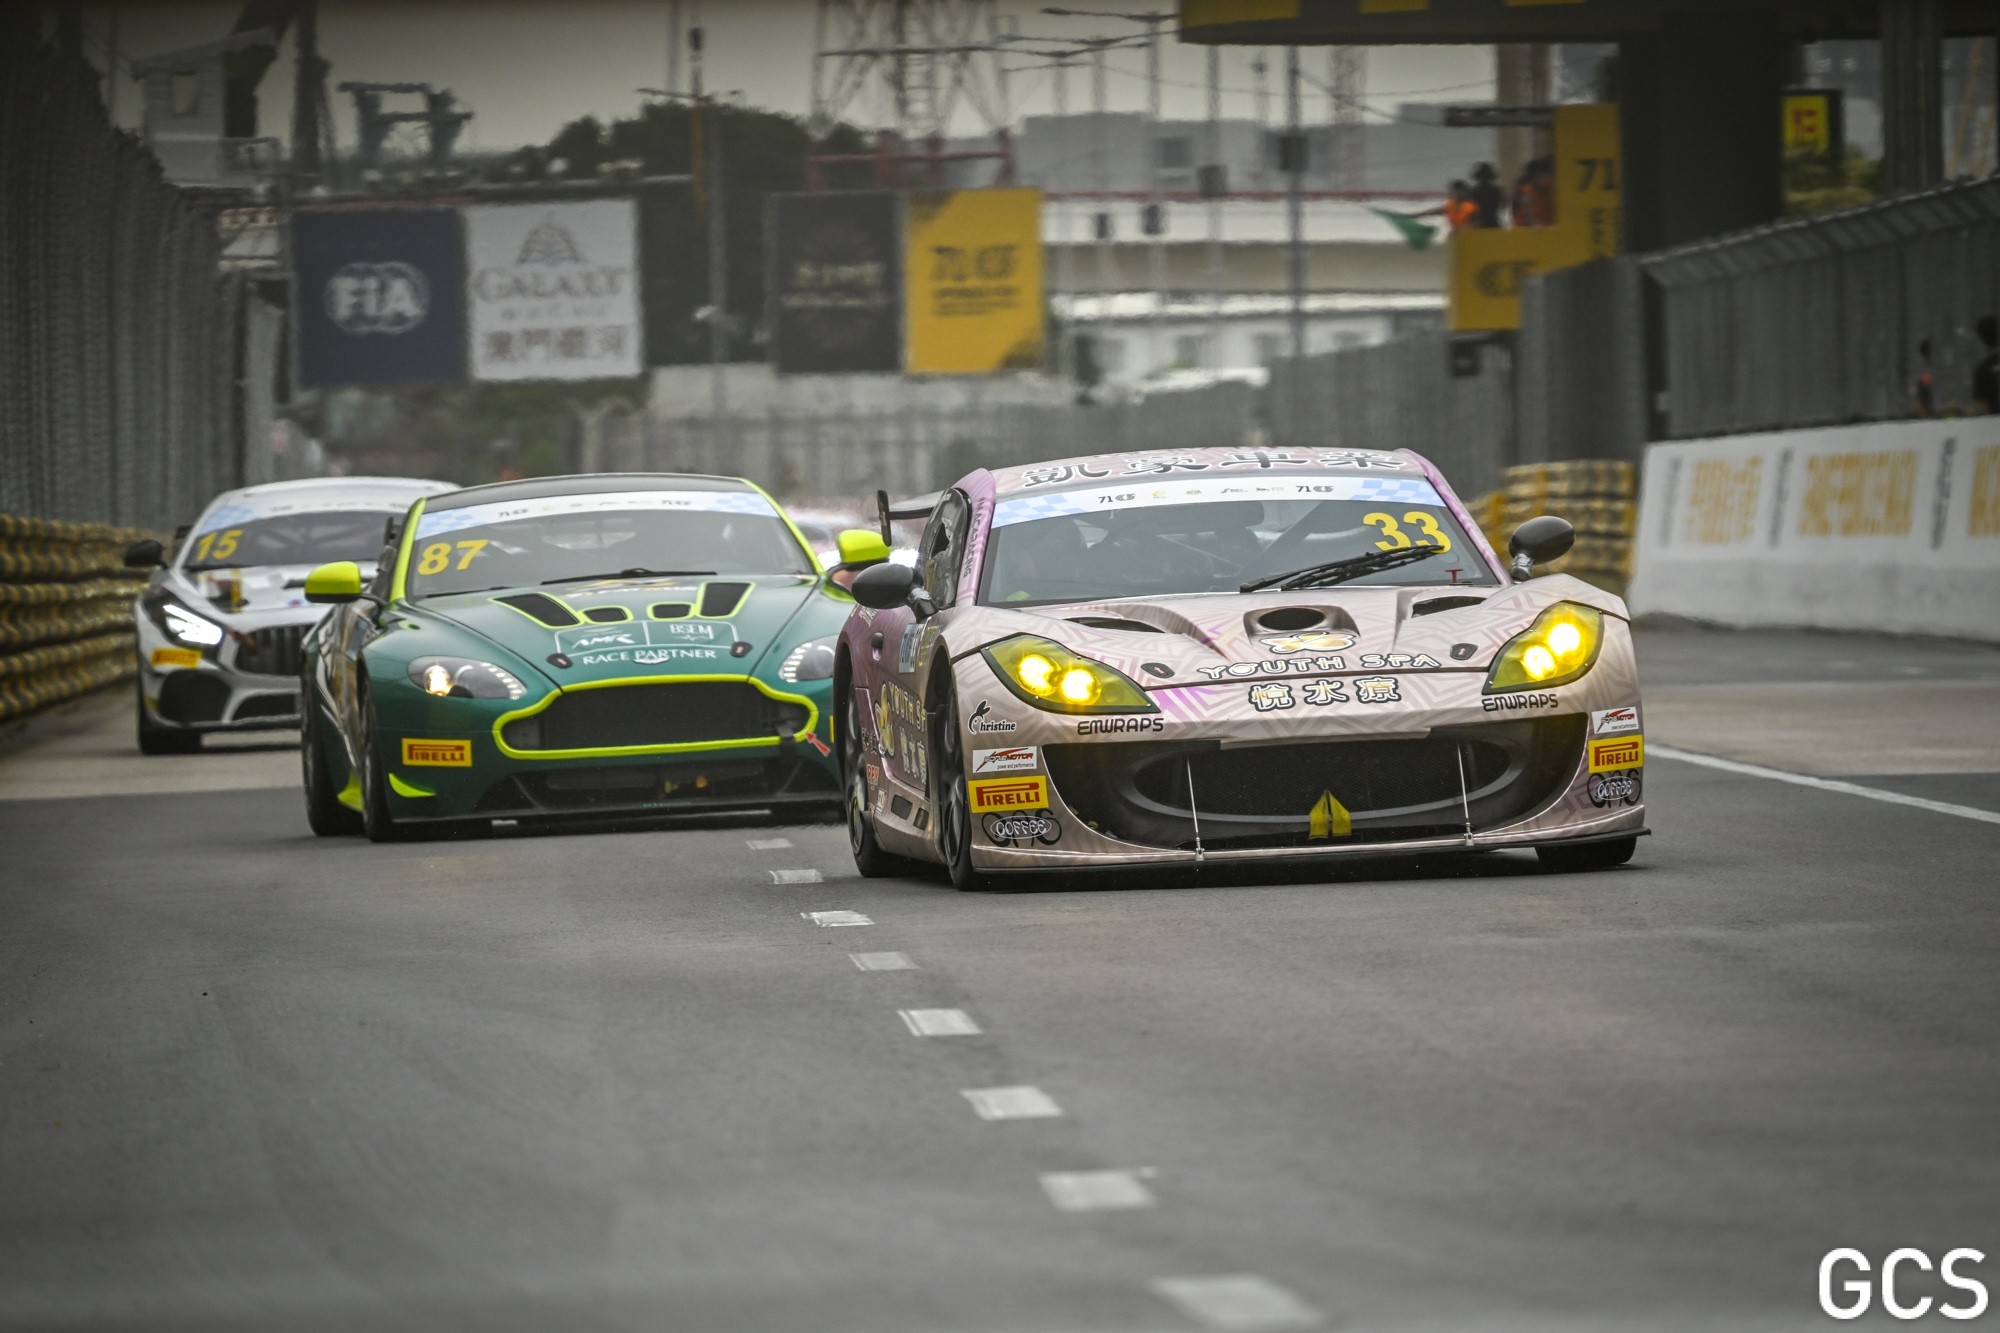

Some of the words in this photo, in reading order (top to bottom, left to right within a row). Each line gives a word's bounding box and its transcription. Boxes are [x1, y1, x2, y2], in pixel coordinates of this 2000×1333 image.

[1362, 511, 1452, 555] 33
[196, 529, 244, 562] 15
[417, 539, 490, 576] 87
[583, 649, 629, 665] RACE
[634, 648, 717, 661] PARTNER
[1197, 656, 1345, 680] YOUTH
[1360, 653, 1442, 669] SPA
[1481, 693, 1559, 712] EMWRAPS
[1077, 717, 1164, 736] EMWRAPS
[408, 744, 464, 761] PIRELLI
[1594, 742, 1639, 766] PIRELLI
[975, 782, 1040, 807] PIRELLI
[995, 819, 1047, 836] COFFEE
